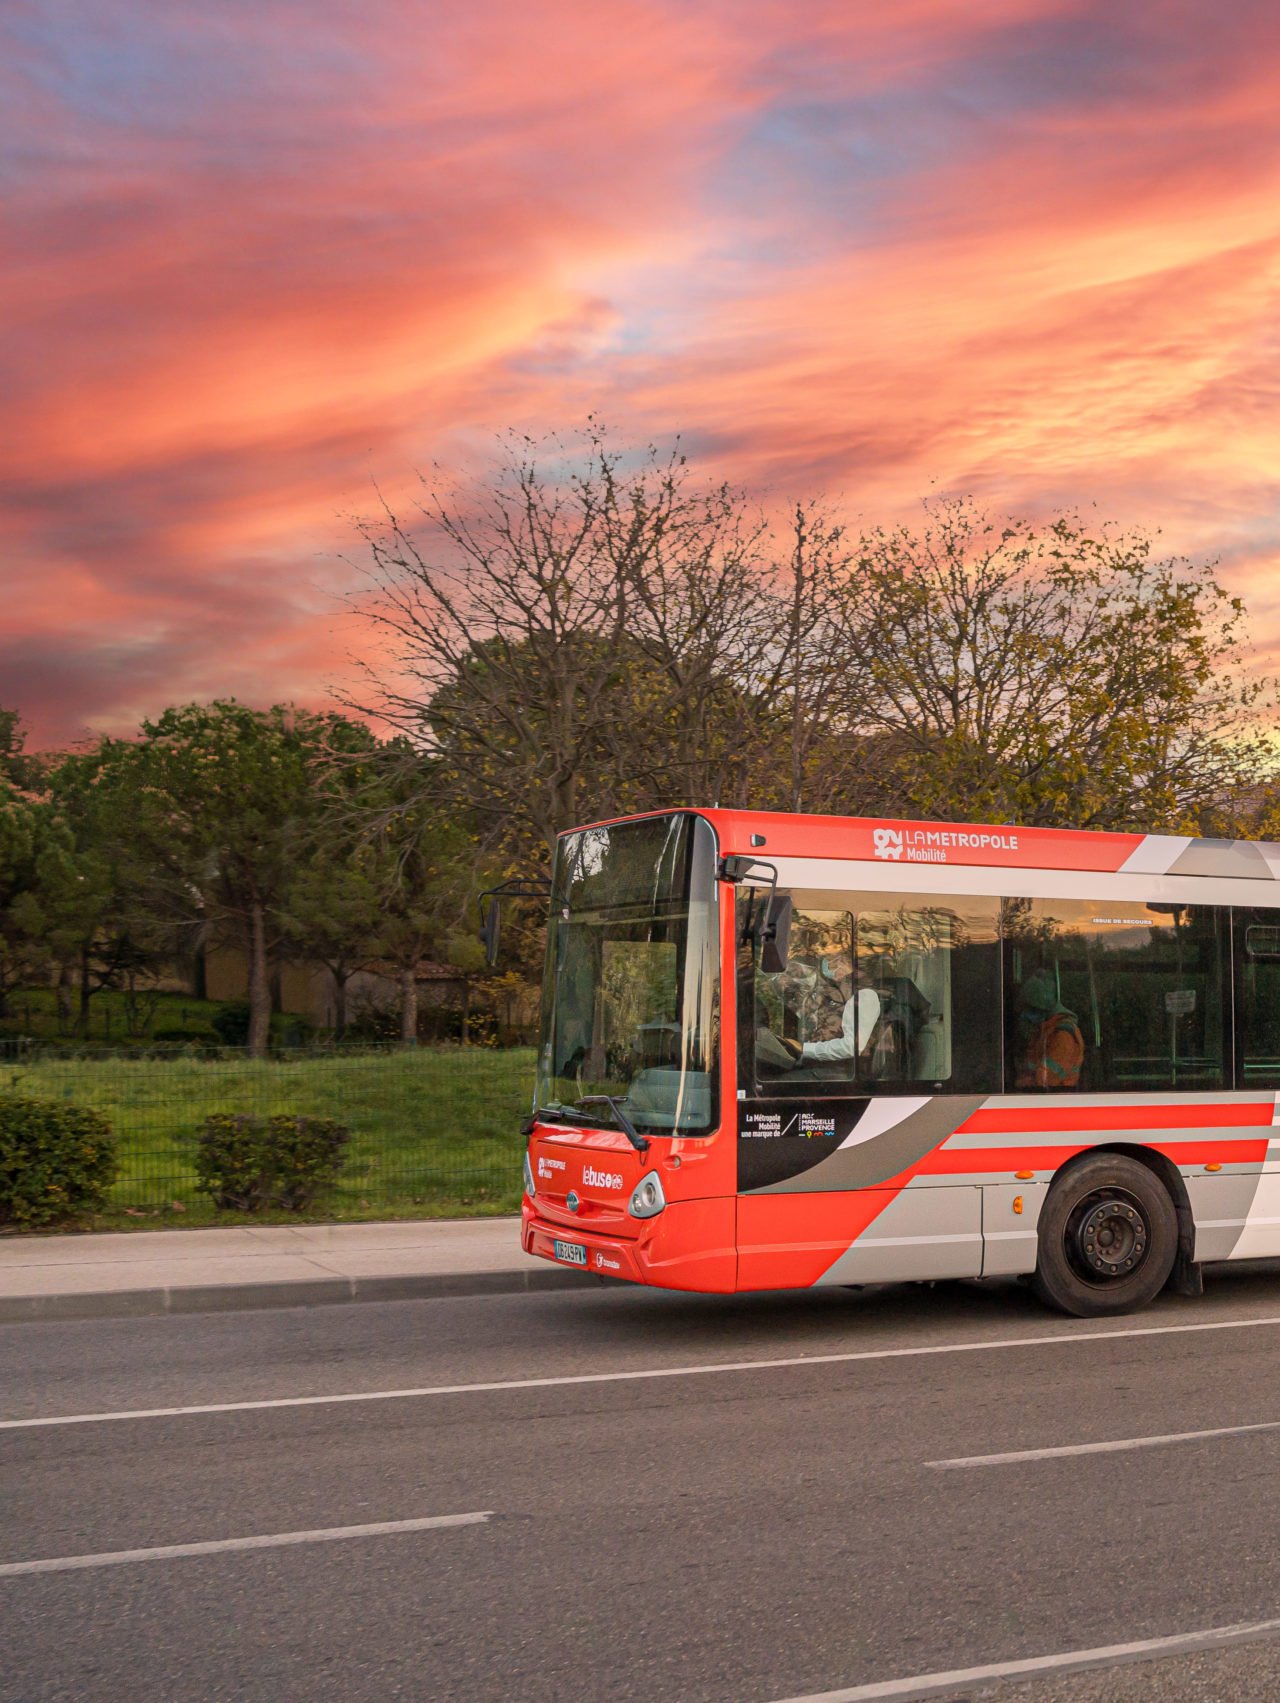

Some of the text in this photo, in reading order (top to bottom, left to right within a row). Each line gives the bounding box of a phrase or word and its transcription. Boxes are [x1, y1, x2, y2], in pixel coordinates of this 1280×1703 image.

[906, 847, 947, 862] Mobilité
[746, 1113, 781, 1123] La Métropole
[758, 1122, 781, 1130] Mobilité
[752, 1131, 773, 1140] marque
